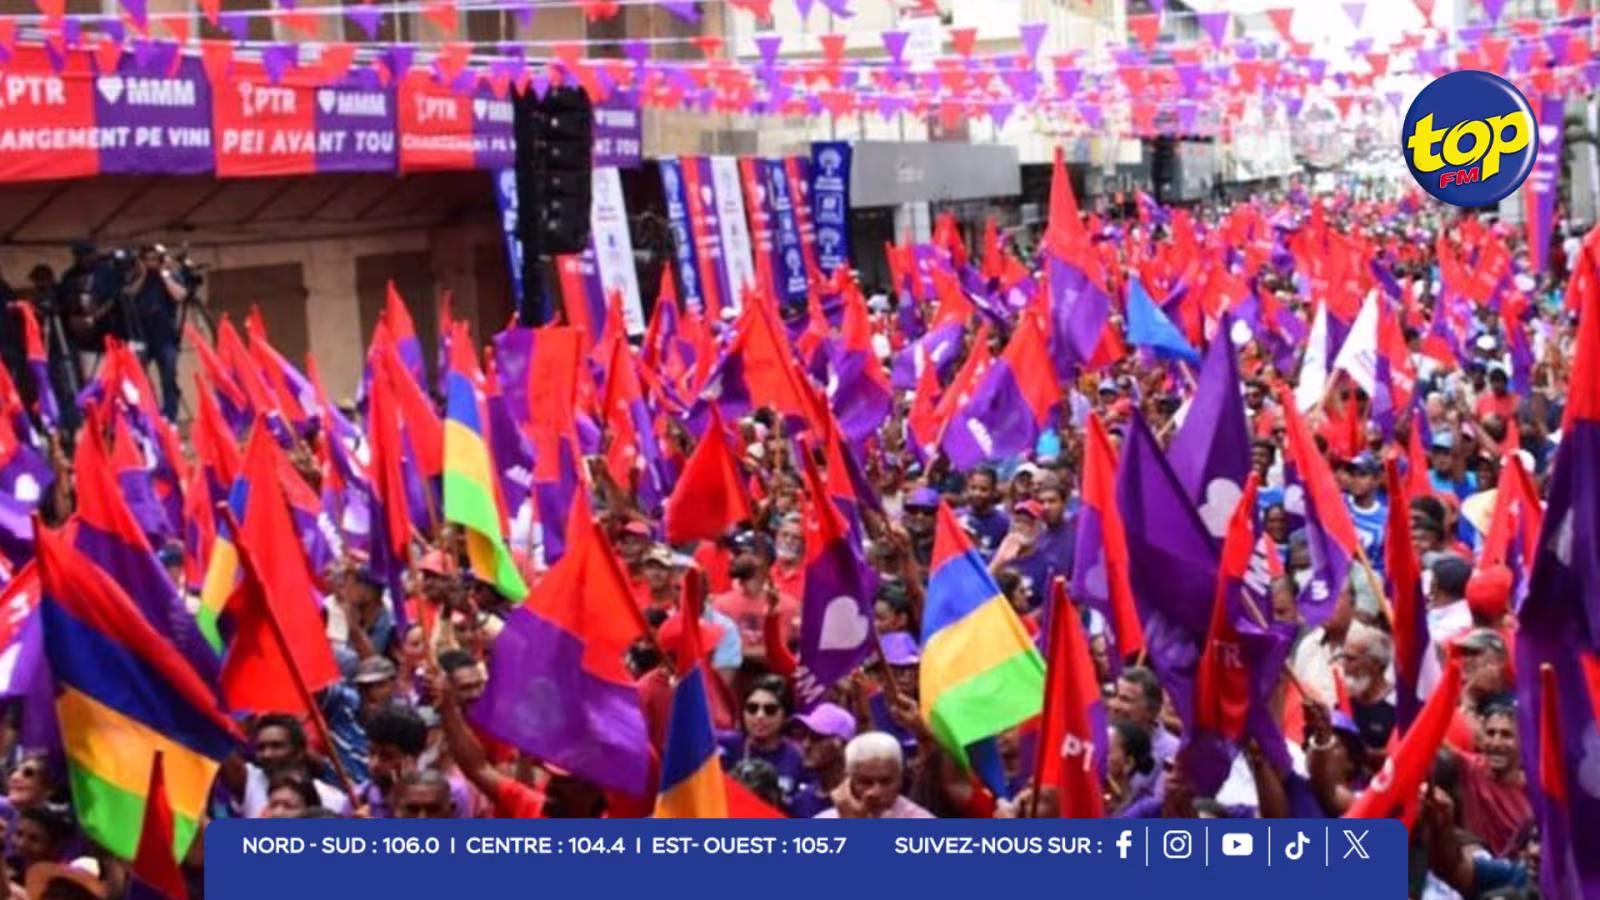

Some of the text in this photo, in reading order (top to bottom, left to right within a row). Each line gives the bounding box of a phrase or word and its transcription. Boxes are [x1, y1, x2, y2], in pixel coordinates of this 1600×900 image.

[6, 75, 66, 105] PTR
[127, 77, 196, 106] MMM
[255, 87, 296, 114] PTR
[337, 92, 387, 116] MMM
[134, 126, 163, 147] PE
[167, 127, 211, 147] VINI
[222, 129, 394, 154] PEI AVANT TOU
